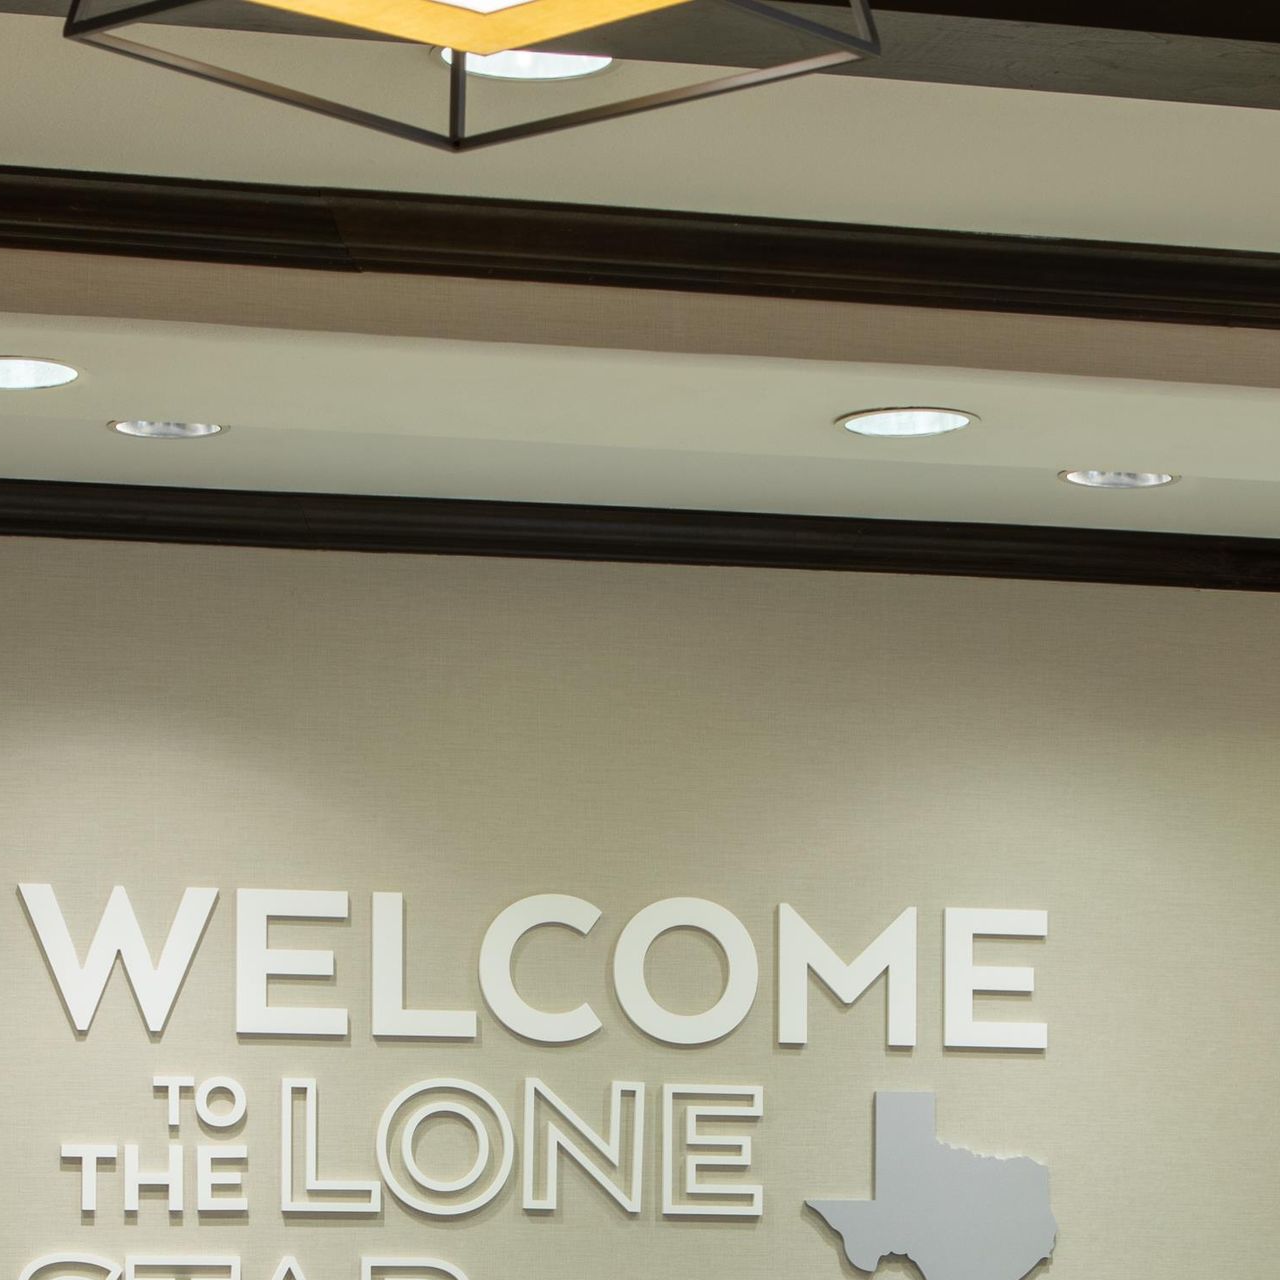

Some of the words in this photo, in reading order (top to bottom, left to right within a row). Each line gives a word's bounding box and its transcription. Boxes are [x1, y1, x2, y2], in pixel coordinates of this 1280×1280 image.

[16, 882, 1048, 1049] WELCOME
[60, 1143, 249, 1213] THE
[281, 1076, 764, 1217] LONE
[152, 1075, 247, 1128] TO
